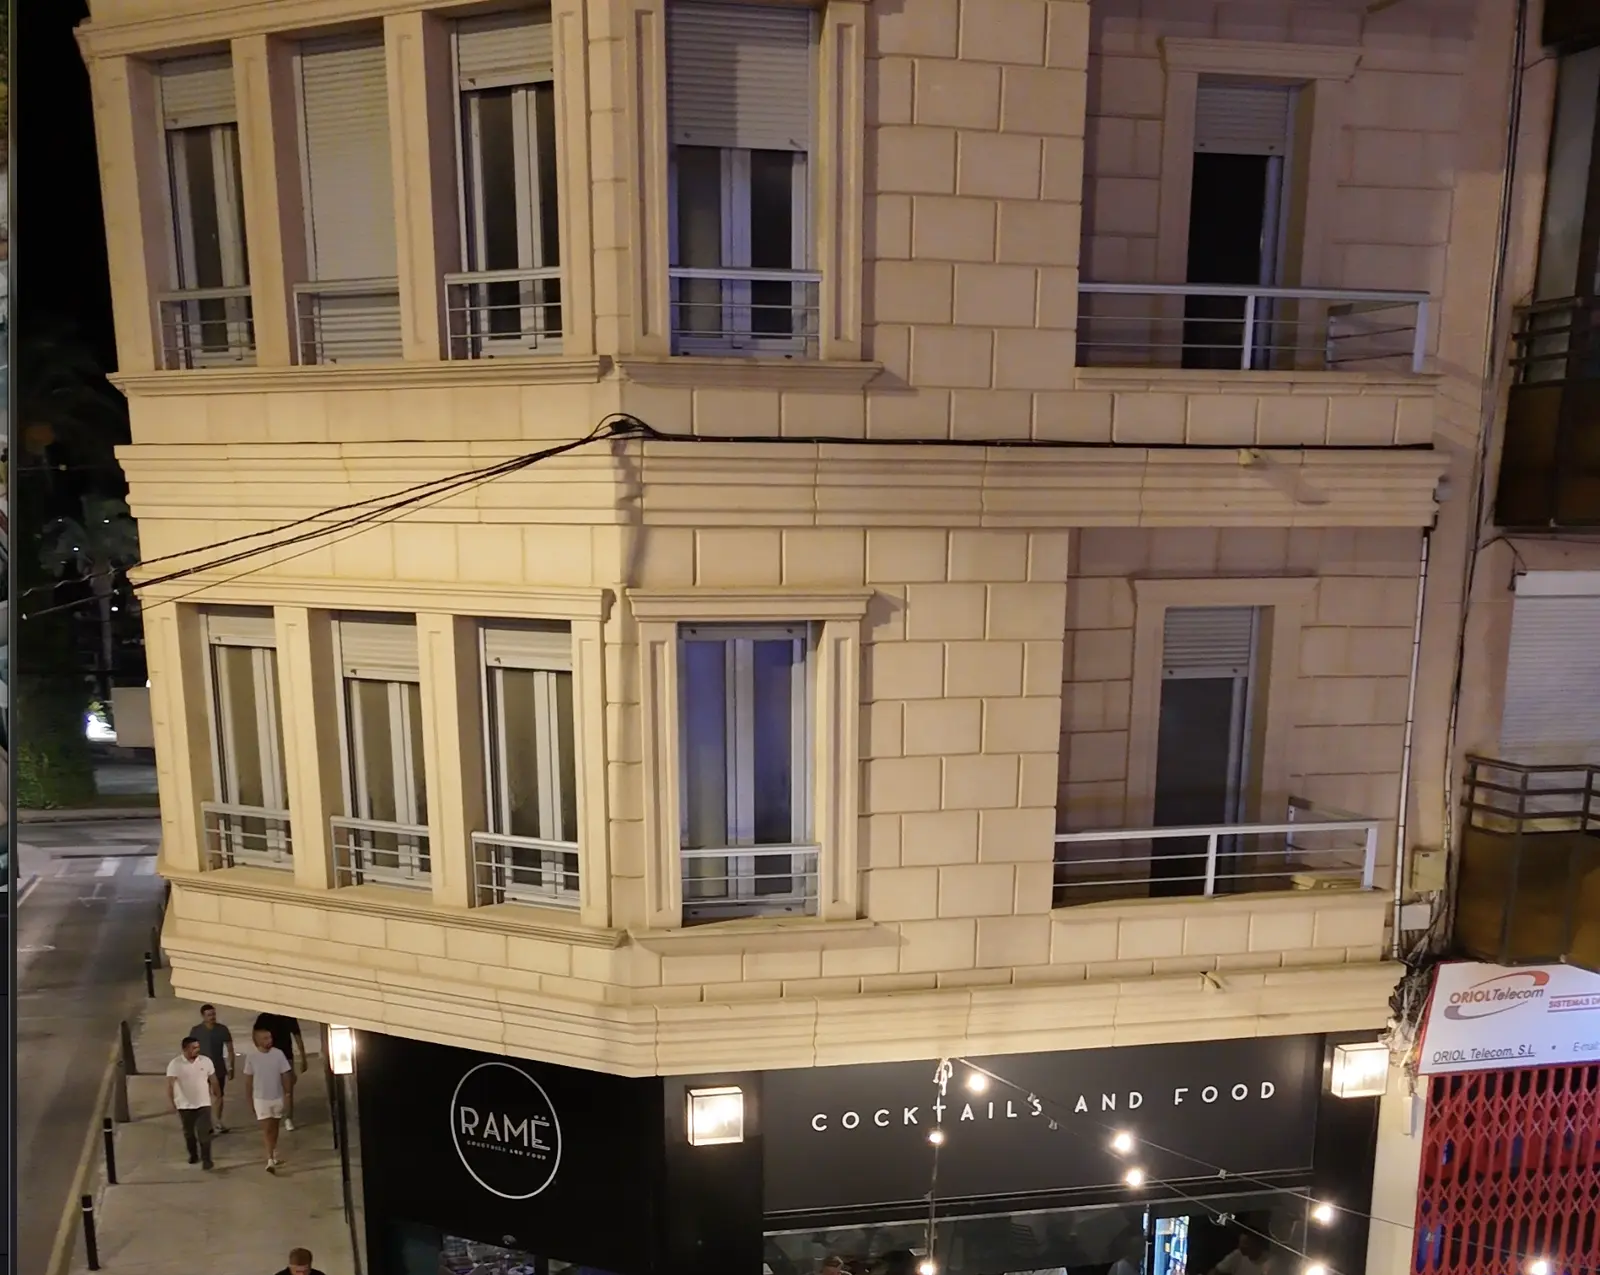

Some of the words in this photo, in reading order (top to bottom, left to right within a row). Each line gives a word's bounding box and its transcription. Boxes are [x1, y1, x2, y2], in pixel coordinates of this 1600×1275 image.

[1548, 998, 1590, 1009] SISTEMAS
[1432, 1050, 1466, 1062] ORIOL
[811, 1098, 1043, 1132] COCKTAILS
[1074, 1091, 1143, 1114] AND
[1173, 1080, 1275, 1106] FOOD
[460, 1105, 551, 1151] RAMË
